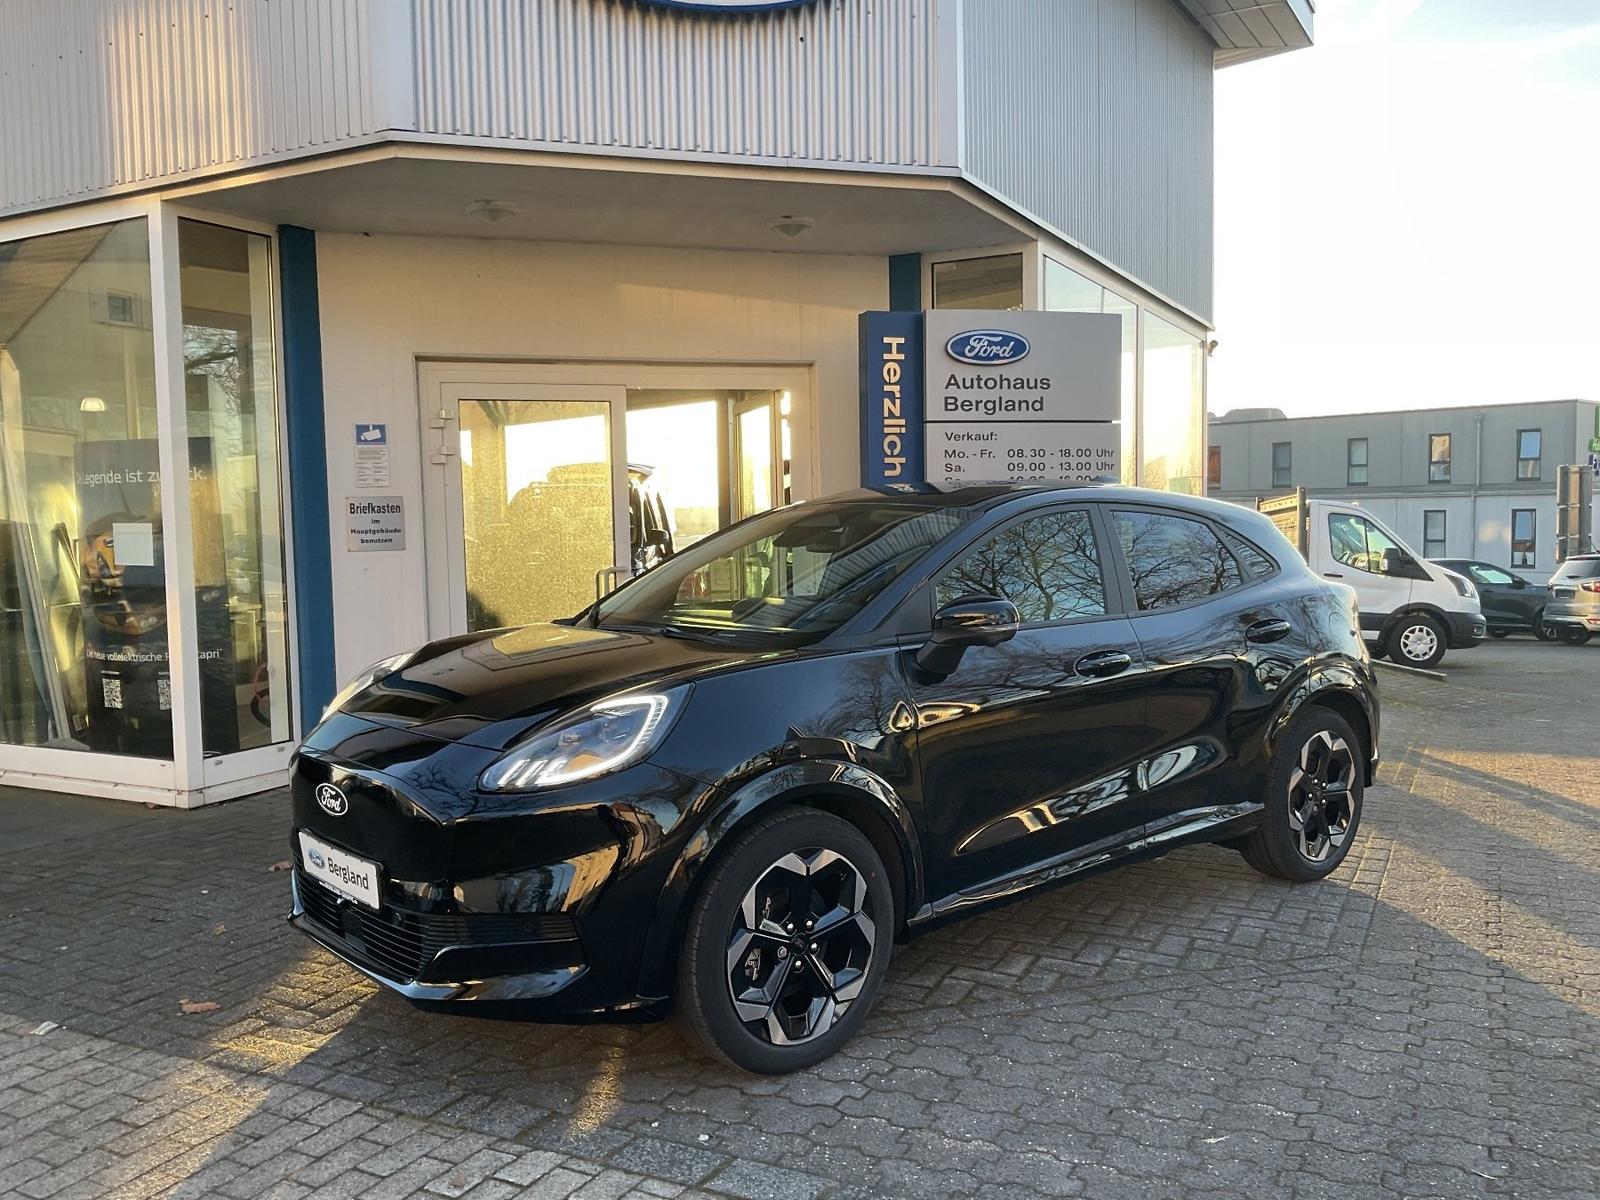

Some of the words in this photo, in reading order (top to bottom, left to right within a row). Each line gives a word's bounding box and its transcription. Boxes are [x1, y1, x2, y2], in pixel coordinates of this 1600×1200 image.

[964, 335, 1016, 358] Ford
[944, 373, 1052, 391] Autohaus
[882, 336, 907, 478] Herzlich
[944, 396, 1045, 416] Bergland
[944, 432, 998, 442] Verkauf:
[944, 449, 969, 459] Mo.
[980, 449, 996, 459] Fr.
[1007, 448, 1046, 459] 08.30
[1059, 448, 1092, 458] 18.00
[1096, 448, 1116, 458] Uhr
[125, 468, 143, 483] ist
[944, 463, 966, 473] Sa.
[1007, 462, 1046, 472] 09.00
[1059, 462, 1092, 472] 13.00
[1096, 462, 1116, 472] Uhr
[349, 502, 402, 514] Briefkasten
[321, 786, 341, 811] Ford
[327, 857, 369, 889] Bergland
